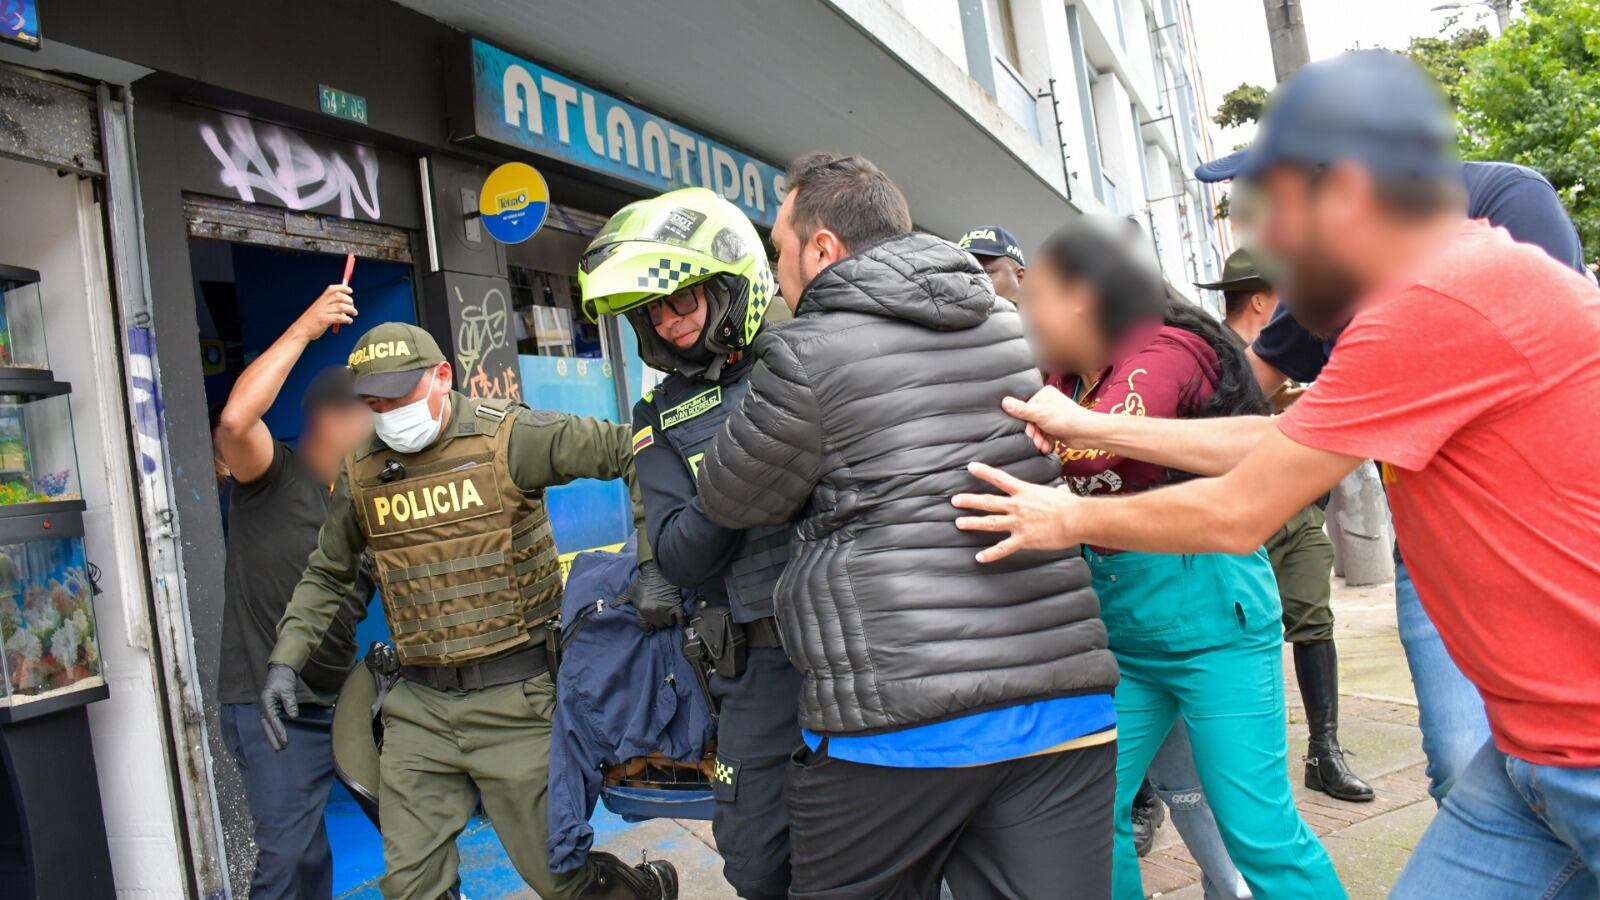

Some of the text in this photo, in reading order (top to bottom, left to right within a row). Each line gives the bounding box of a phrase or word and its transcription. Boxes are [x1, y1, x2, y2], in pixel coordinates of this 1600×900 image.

[503, 64, 765, 212] ATLANTIDA
[348, 341, 411, 367] POLICIA
[374, 478, 484, 526] POLICIA
